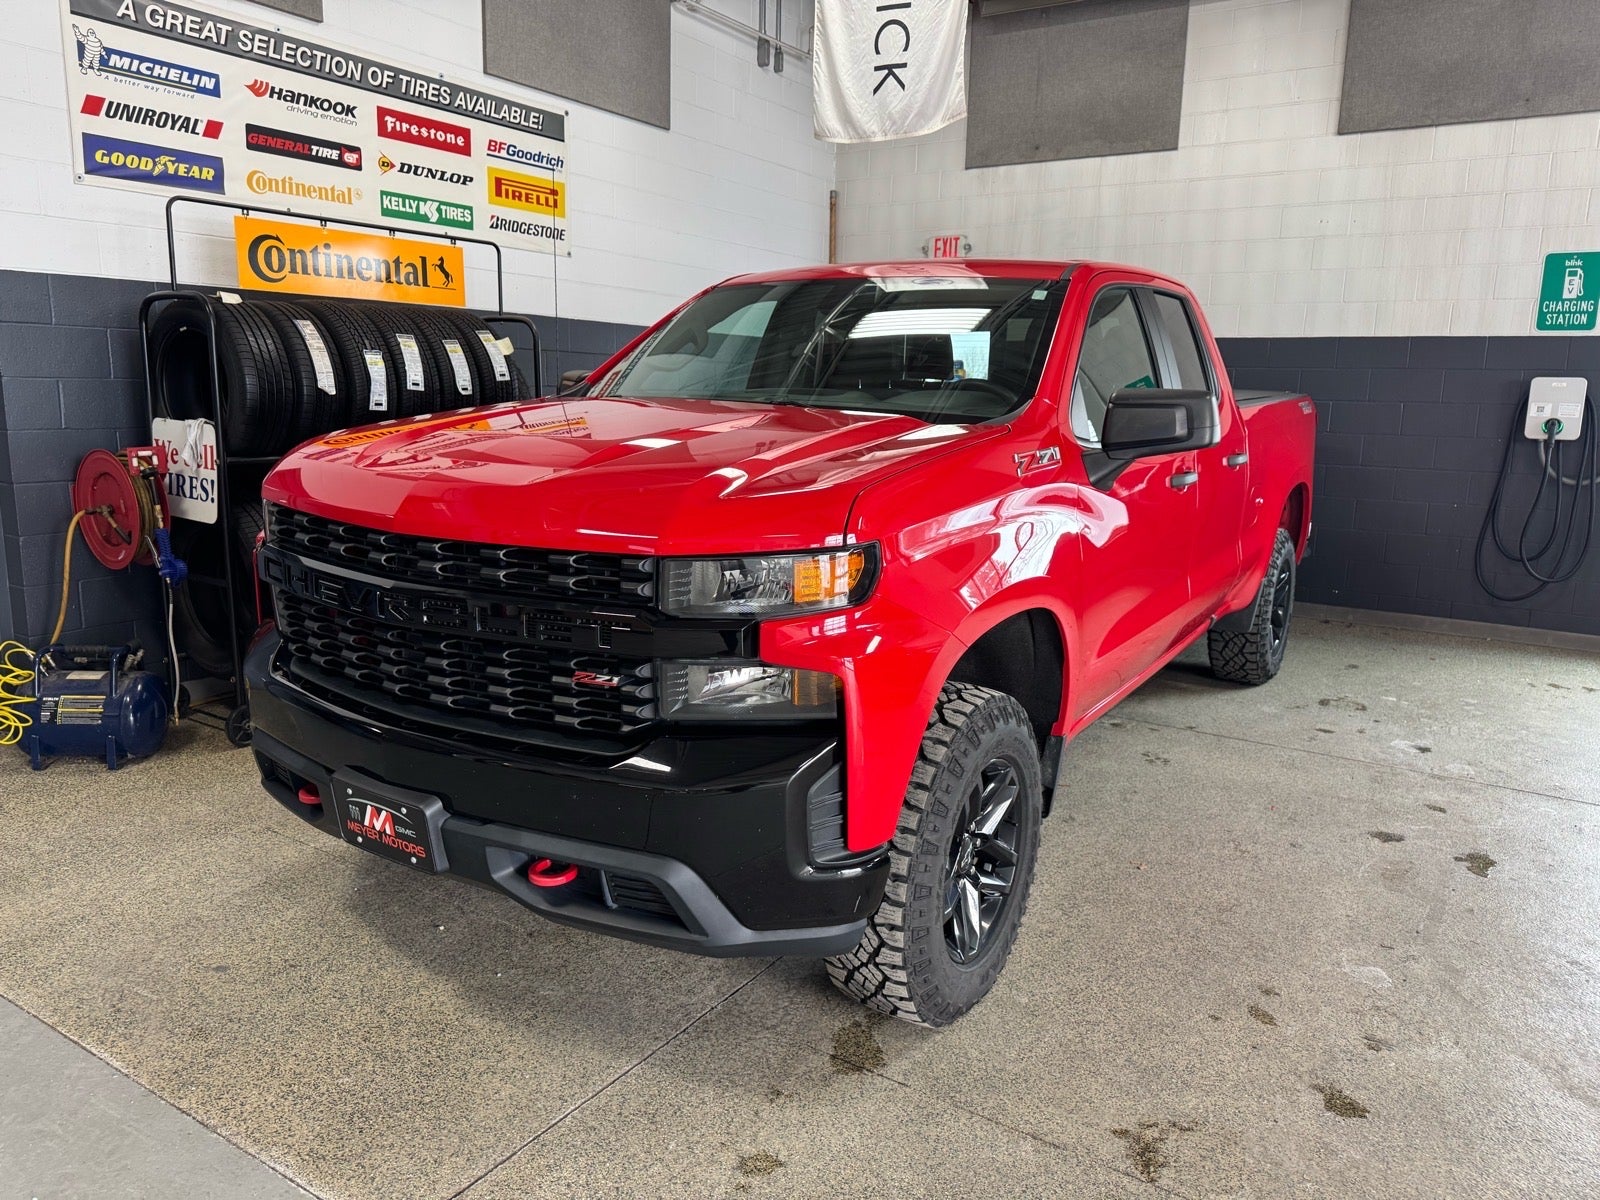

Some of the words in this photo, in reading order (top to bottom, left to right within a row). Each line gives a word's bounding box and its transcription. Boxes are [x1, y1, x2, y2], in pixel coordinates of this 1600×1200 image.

[108, 54, 216, 90] MICHELIN
[116, 0, 138, 21] A
[144, 4, 233, 46] GREAT
[237, 29, 362, 81] SELECTION
[367, 66, 395, 89] OF
[399, 74, 451, 105] TIRES
[454, 91, 544, 130] AVAILABLE!
[114, 77, 141, 88] better
[144, 84, 160, 93] way
[163, 87, 196, 100] forward
[104, 100, 200, 136] UNIROYAL
[286, 105, 319, 118] driving
[320, 113, 358, 127] emotion
[384, 115, 466, 147] Firestone
[487, 138, 564, 169] BFGoodrich
[246, 169, 353, 205] Continental
[397, 162, 474, 186] DUNLOP
[494, 176, 559, 209] PIRELLI
[382, 195, 418, 214] KELLY
[440, 204, 472, 223] TIRES
[489, 214, 566, 241] BRIDGESTONE
[248, 233, 430, 288] Continental
[934, 236, 960, 258] EXIT
[1543, 300, 1595, 312] CHARGING
[1545, 313, 1588, 325] STATION
[166, 472, 215, 504] IRES!
[347, 820, 381, 841] MEYER
[382, 833, 426, 858] MOTORS
[395, 825, 417, 838] GMC
